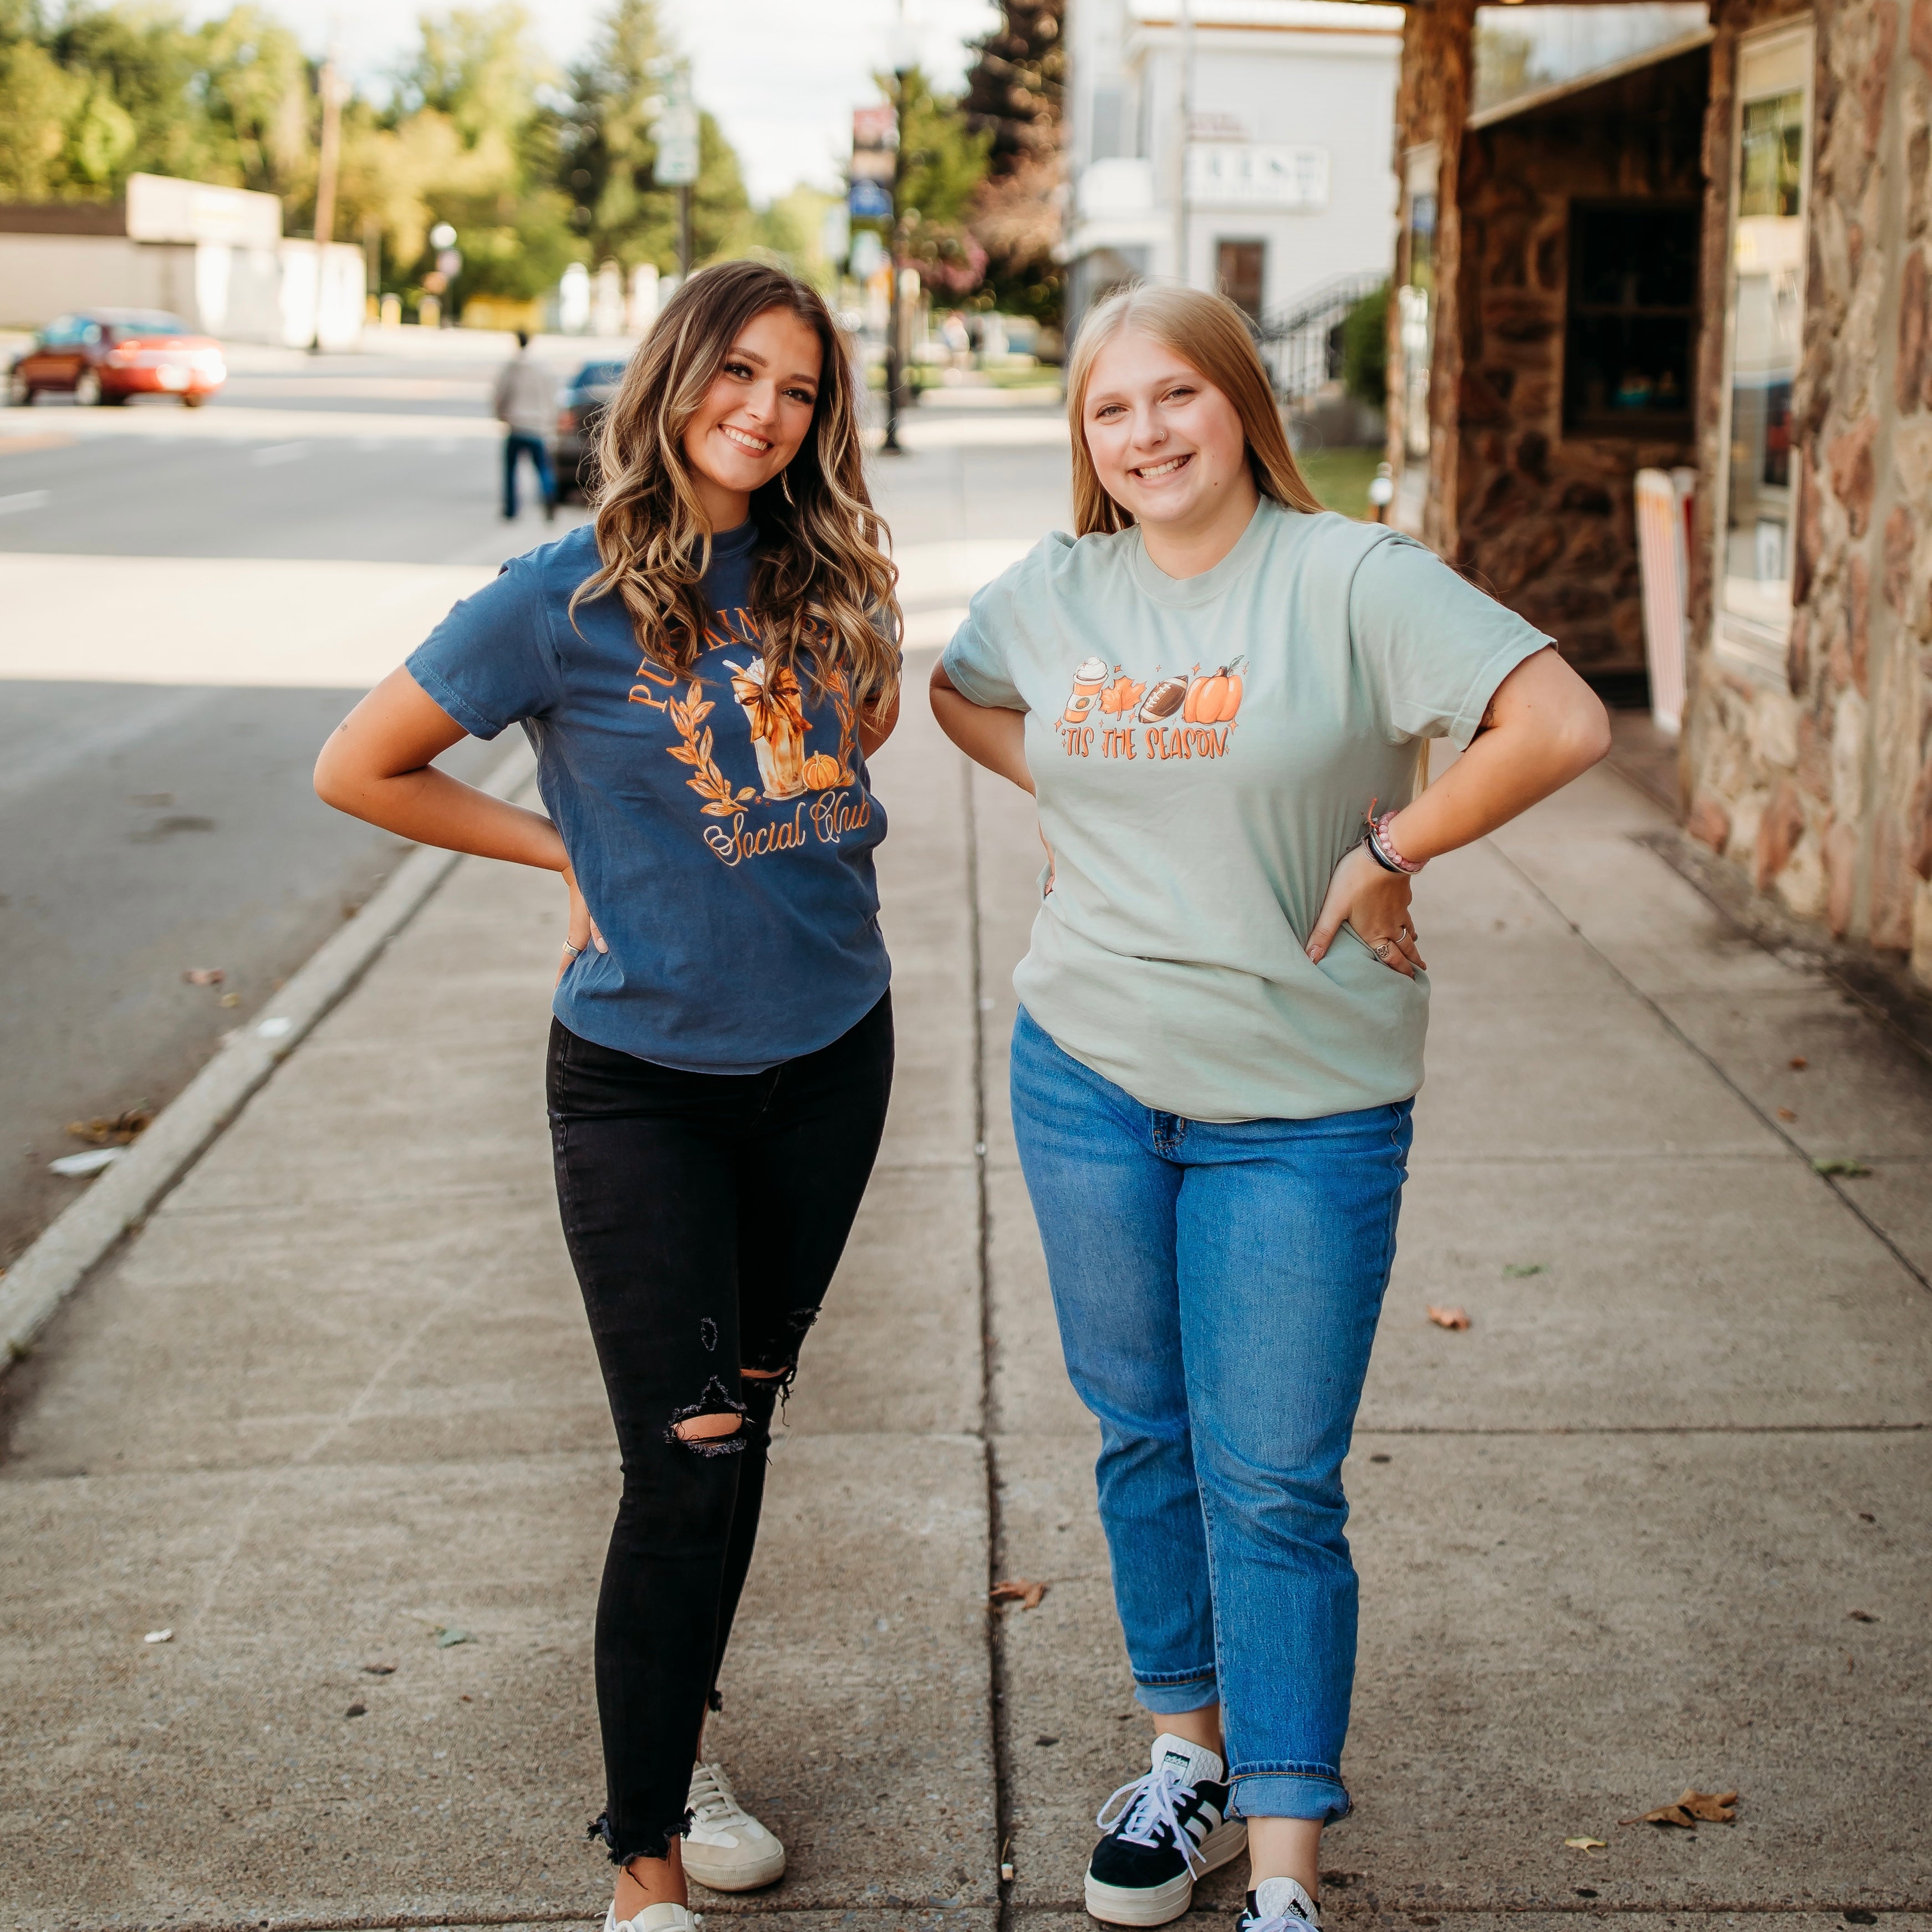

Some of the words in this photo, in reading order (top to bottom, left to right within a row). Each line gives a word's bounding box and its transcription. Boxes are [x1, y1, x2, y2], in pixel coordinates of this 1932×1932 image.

[1102, 727, 1137, 760] THE
[1145, 727, 1228, 760] SEASON
[703, 802, 807, 866] Social
[809, 790, 871, 843] Club
[1165, 1755, 1188, 1767] adidas
